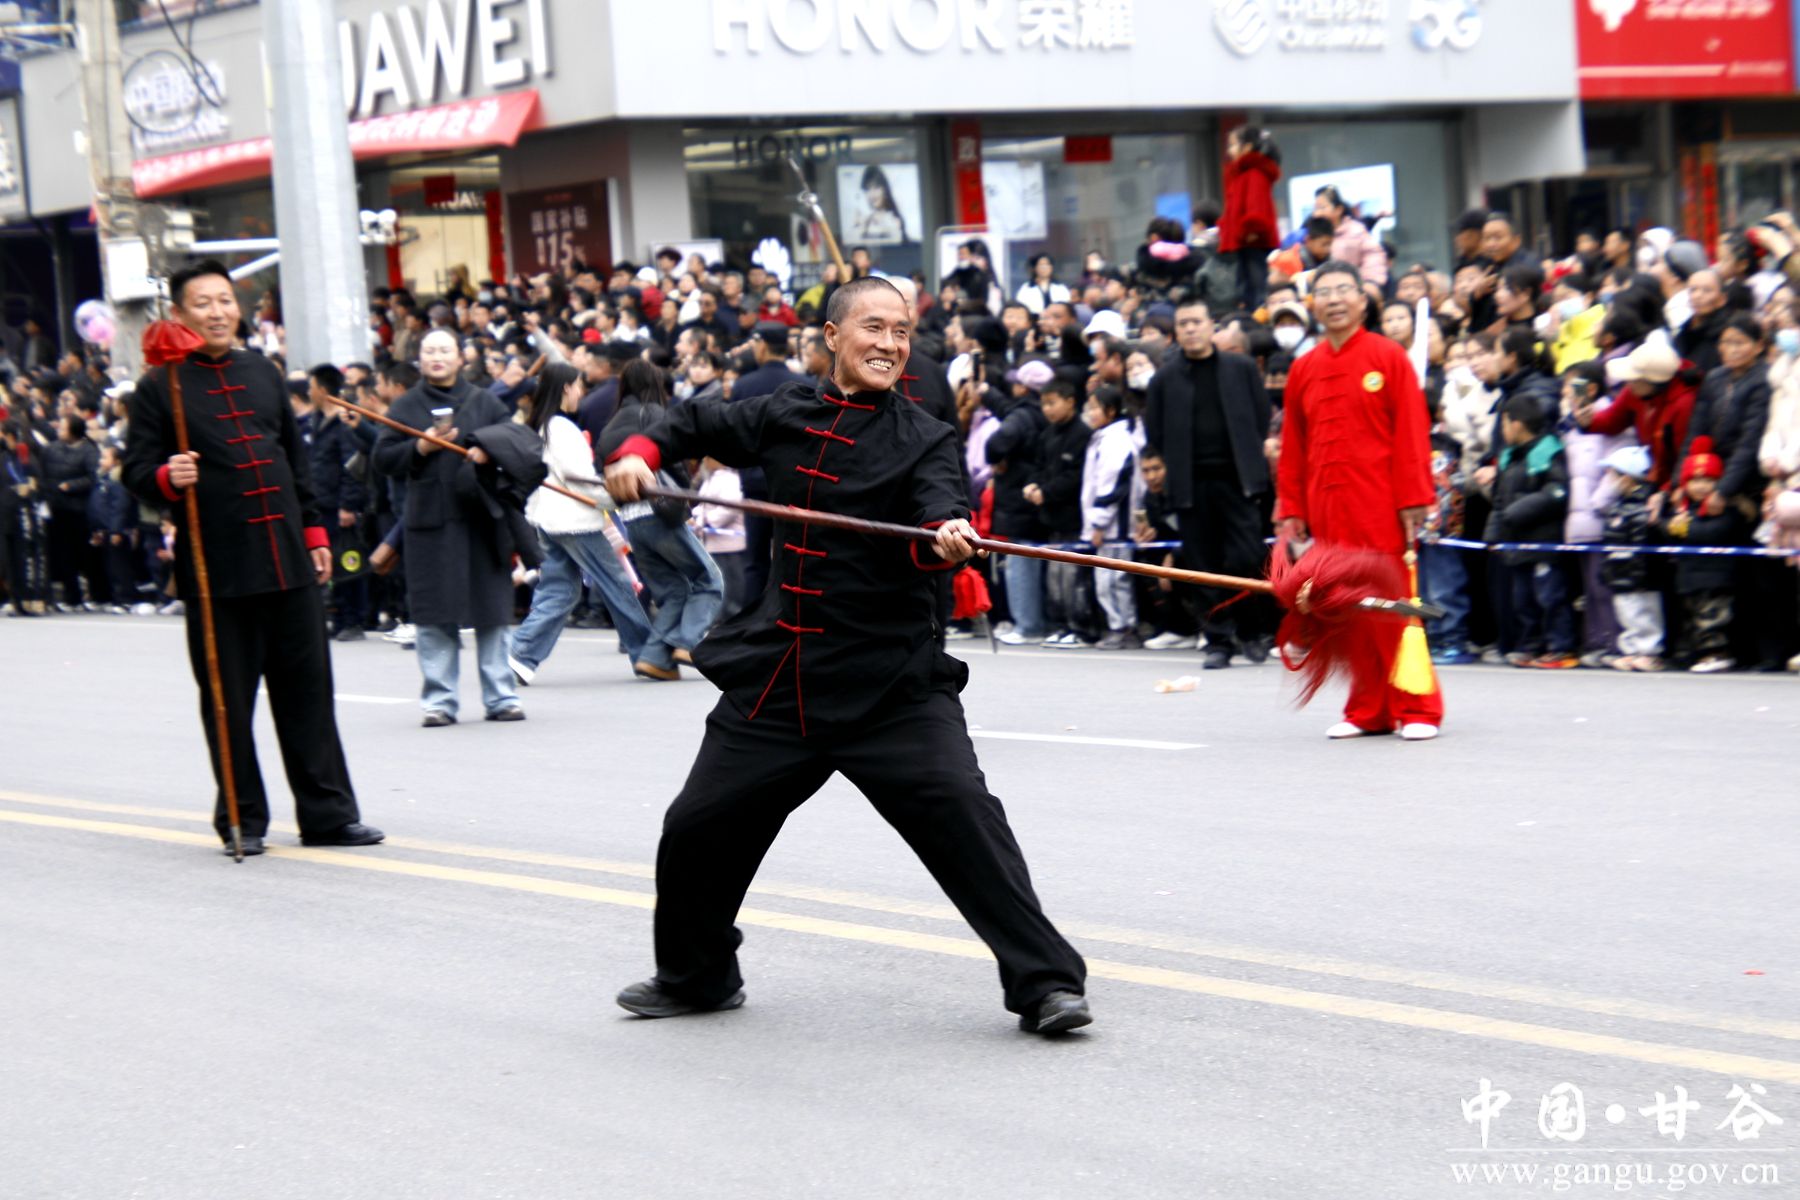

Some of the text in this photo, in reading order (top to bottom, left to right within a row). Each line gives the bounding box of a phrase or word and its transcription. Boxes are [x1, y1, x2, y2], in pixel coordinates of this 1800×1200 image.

[713, 0, 1003, 53] HONOR
[1017, 0, 1135, 48] 荣耀
[261, 0, 548, 134] AWEI
[734, 134, 851, 164] HONOR
